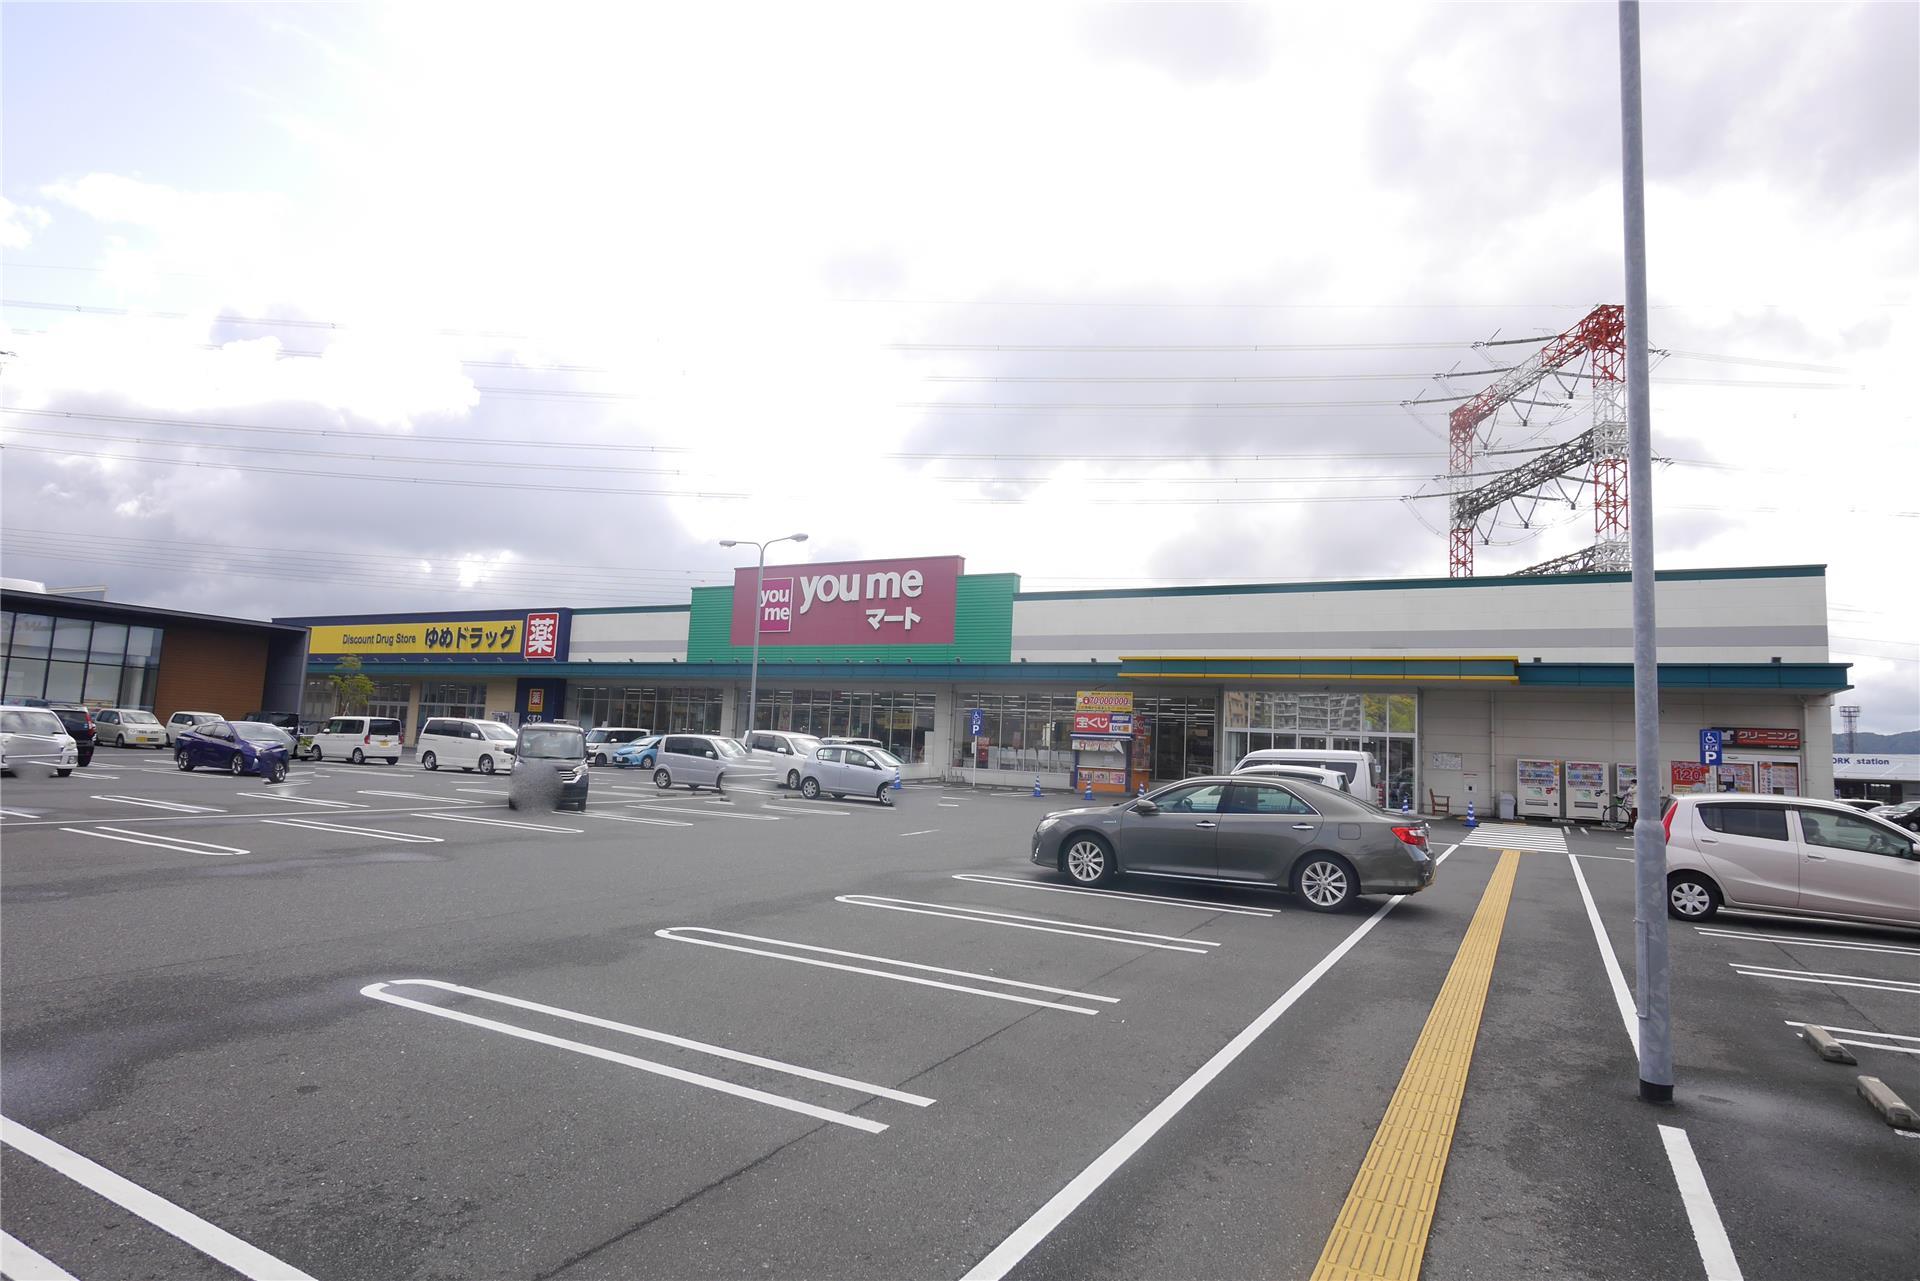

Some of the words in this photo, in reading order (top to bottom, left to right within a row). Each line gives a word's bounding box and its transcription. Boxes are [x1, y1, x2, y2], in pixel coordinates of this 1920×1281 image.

[760, 589, 790, 607] you
[800, 573, 861, 614] you
[866, 569, 924, 599] me
[764, 607, 790, 621] me
[866, 606, 921, 630] マート
[342, 633, 374, 645] Discount
[376, 633, 394, 646] Drug
[396, 632, 417, 644] Store
[425, 625, 518, 649] ゆめドラッグ
[528, 618, 555, 653] 薬
[972, 725, 980, 734] P
[1076, 716, 1108, 729] 宝くじ
[1738, 730, 1798, 741] クリーニング
[1705, 751, 1717, 764] P
